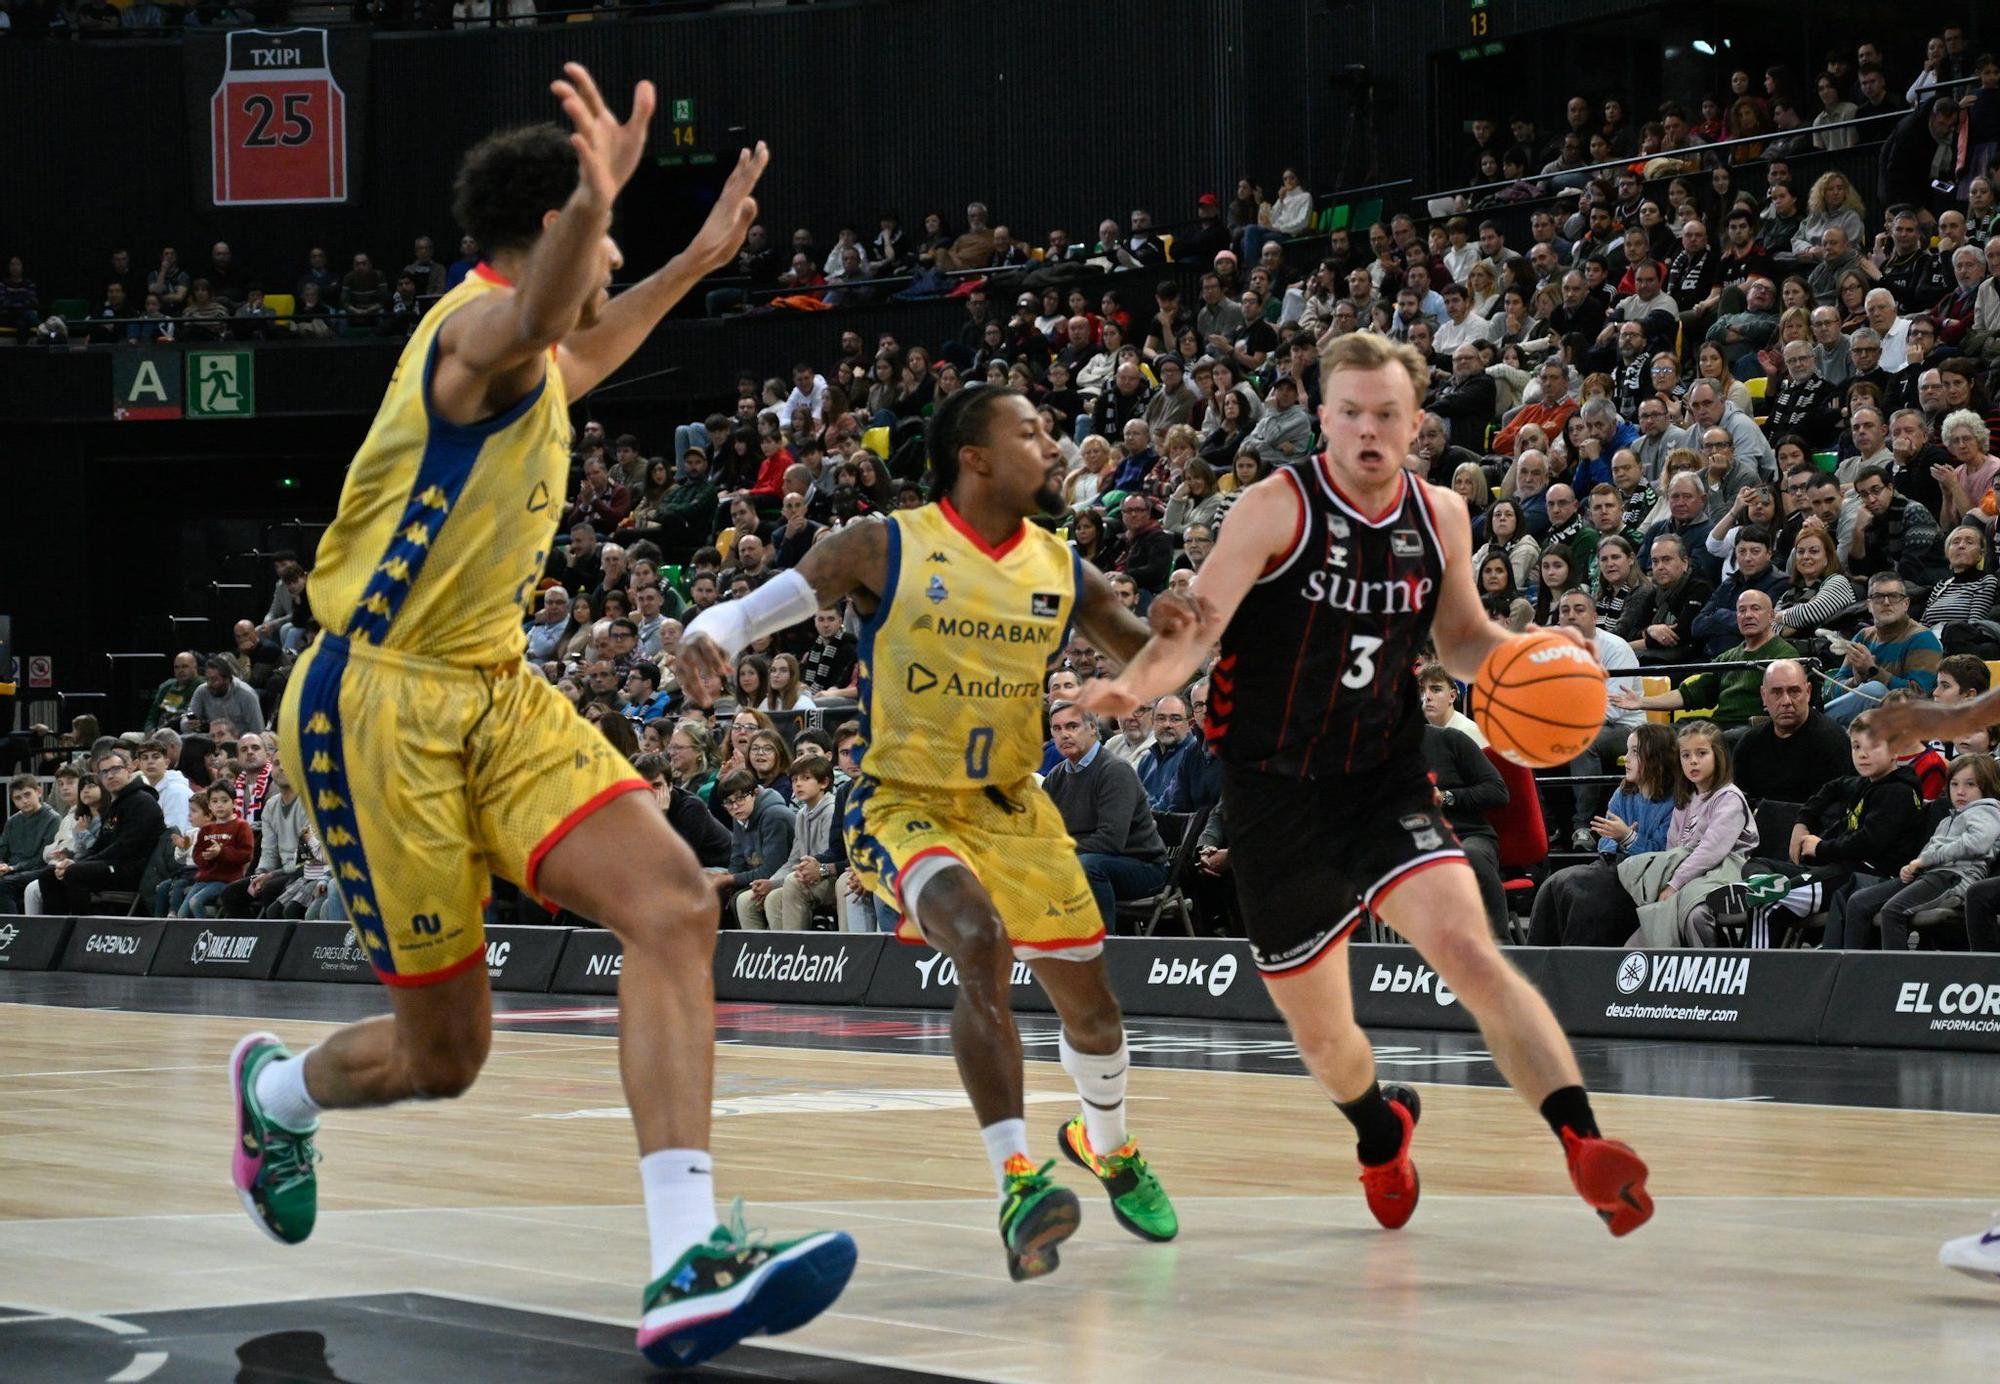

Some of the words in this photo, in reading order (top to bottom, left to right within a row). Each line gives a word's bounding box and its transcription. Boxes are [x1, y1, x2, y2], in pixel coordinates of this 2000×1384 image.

[1471, 12, 1487, 36] 13
[250, 48, 301, 66] TXIPI
[241, 92, 314, 148] 25
[673, 126, 694, 146] 14
[128, 360, 168, 402] A
[1301, 570, 1432, 614] surne
[1341, 634, 1384, 689] 3
[943, 672, 1041, 698] Andorra
[965, 727, 994, 779] 0
[207, 936, 229, 958] TAKE
[312, 946, 338, 960] FLORES
[484, 941, 511, 966] AC
[732, 942, 849, 983] kutxabank
[1147, 957, 1209, 985] bbk
[1648, 955, 1751, 995] YAMAHA
[1369, 963, 1435, 994] bbk
[1605, 1002, 1738, 1022] deustomotocenter.com
[1895, 982, 1933, 1013] EL
[1938, 983, 2000, 1015] COR
[1930, 1019, 2000, 1032] INFORMACIÓN
